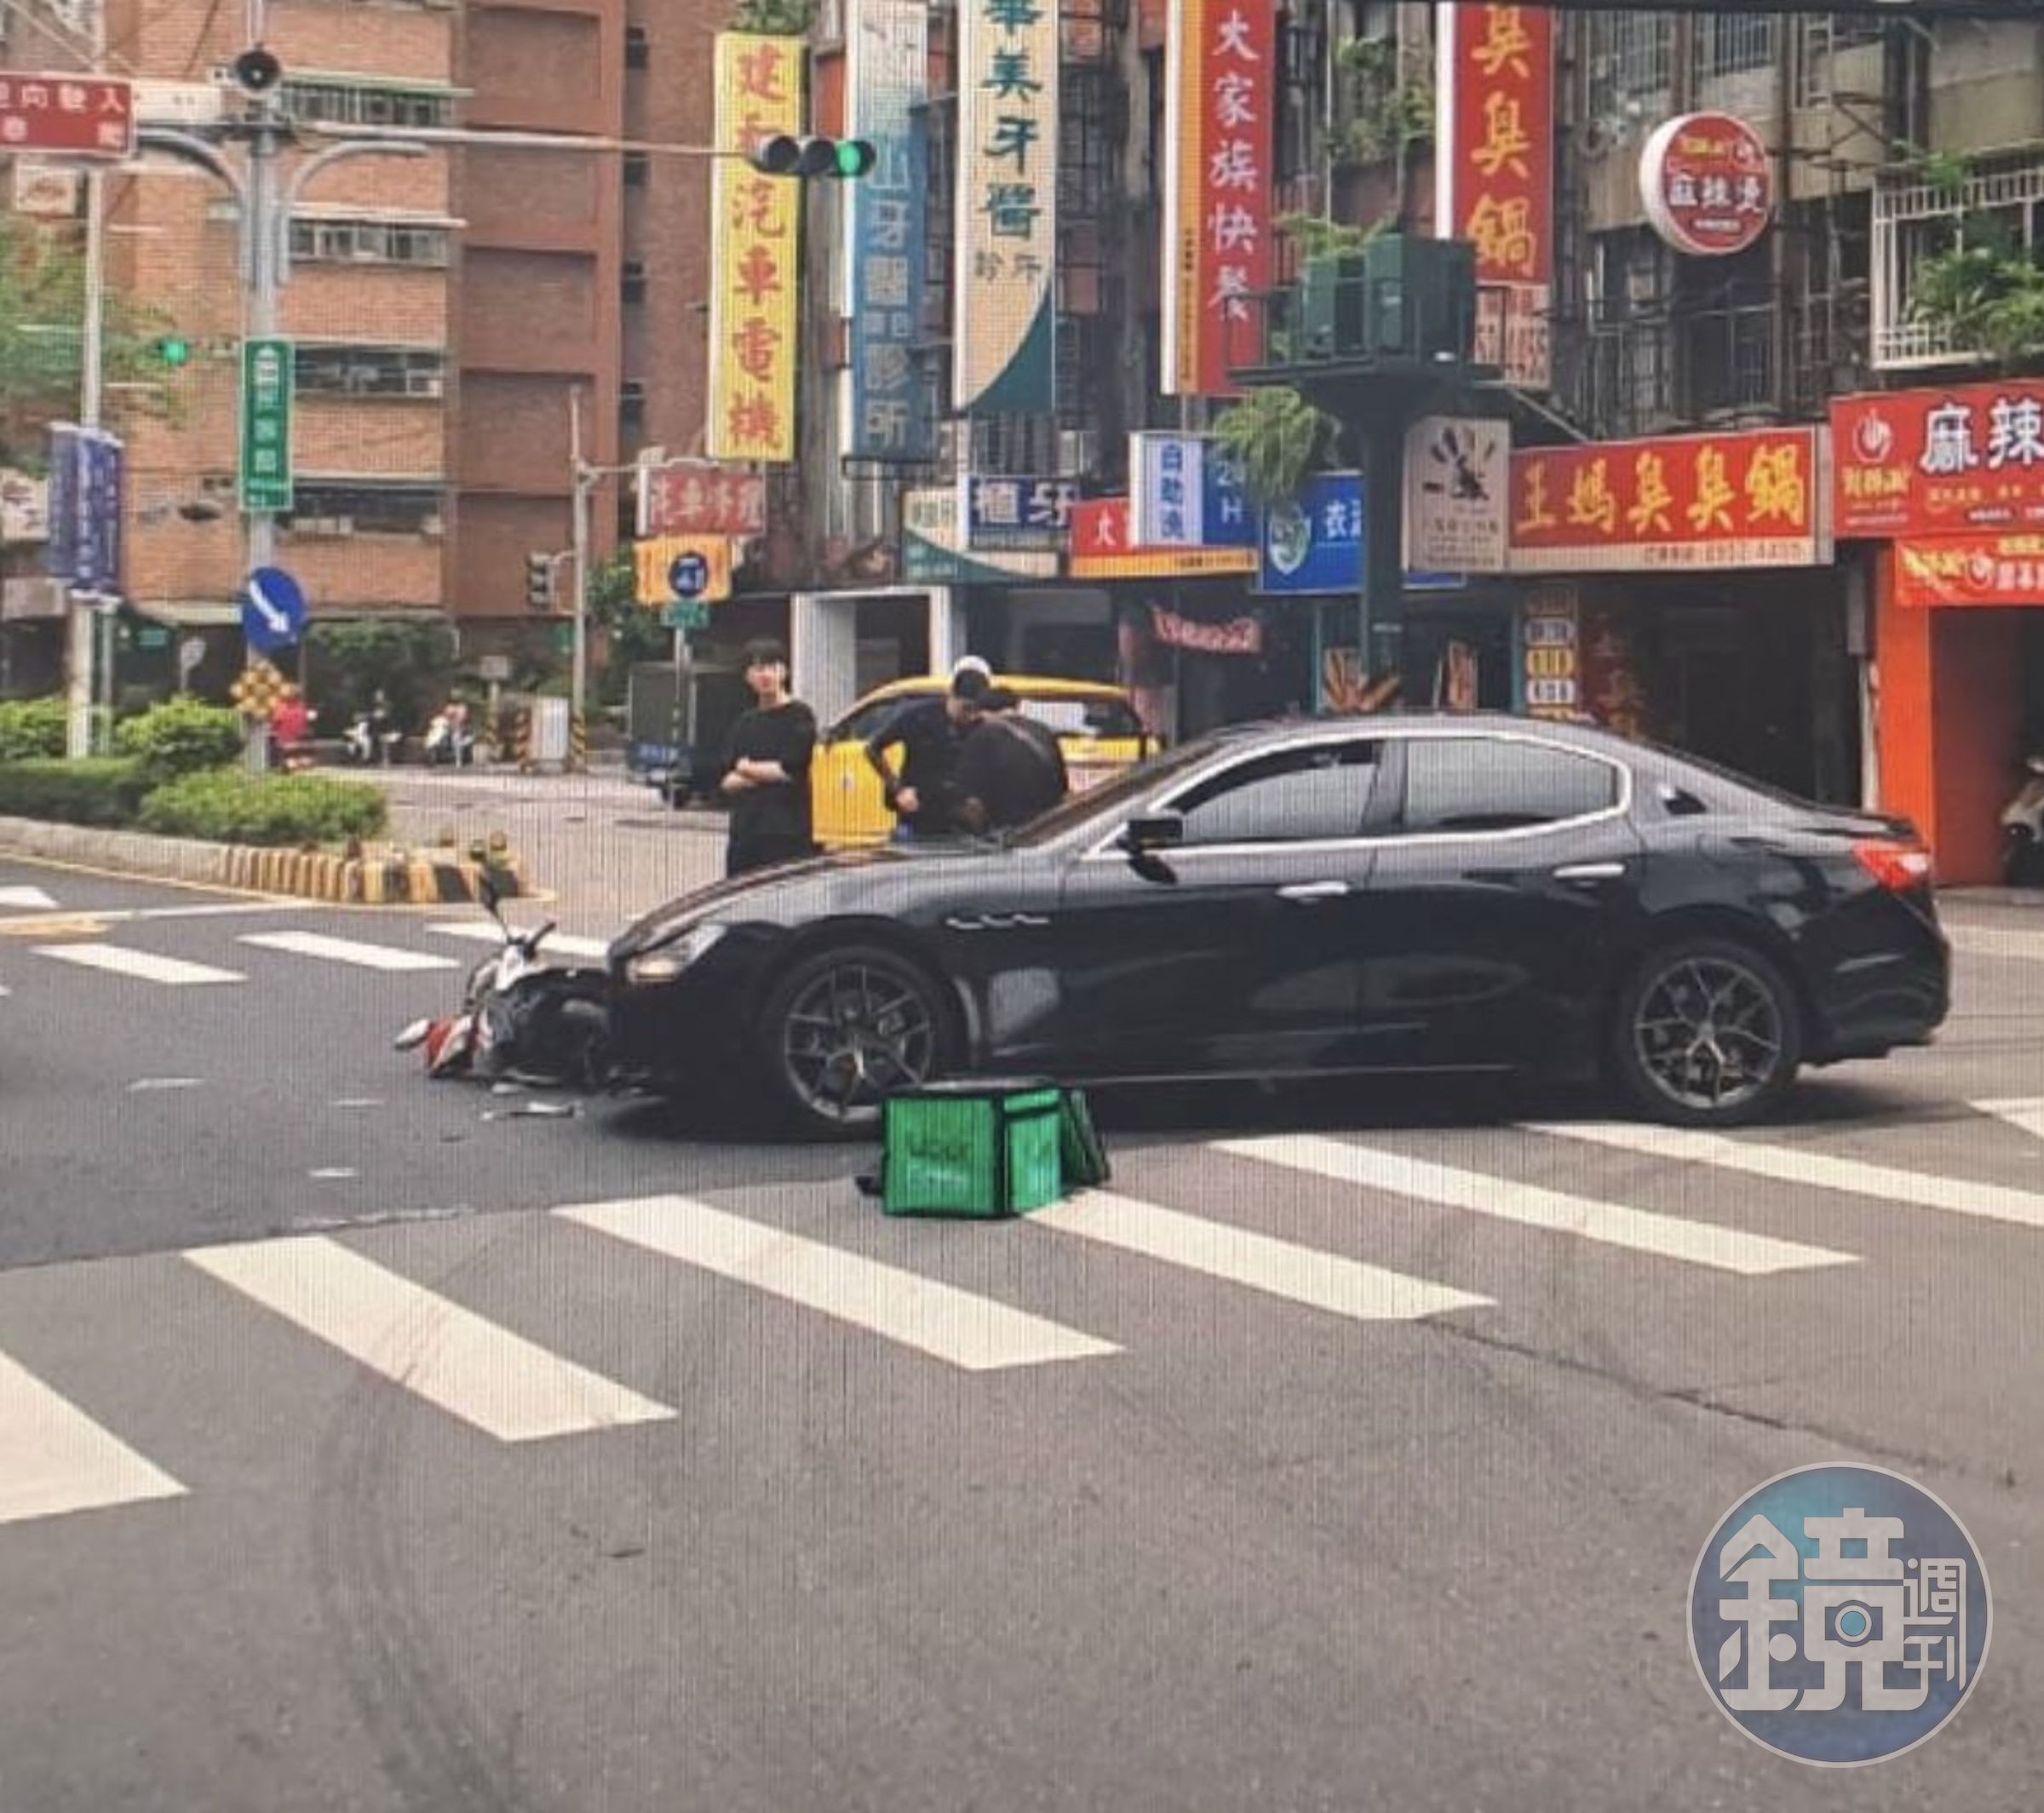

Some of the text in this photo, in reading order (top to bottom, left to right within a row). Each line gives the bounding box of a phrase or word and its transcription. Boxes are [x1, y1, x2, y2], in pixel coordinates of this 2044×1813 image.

[1206, 10, 1260, 322] 大家族快餐
[1919, 396, 2044, 474] 麻辣
